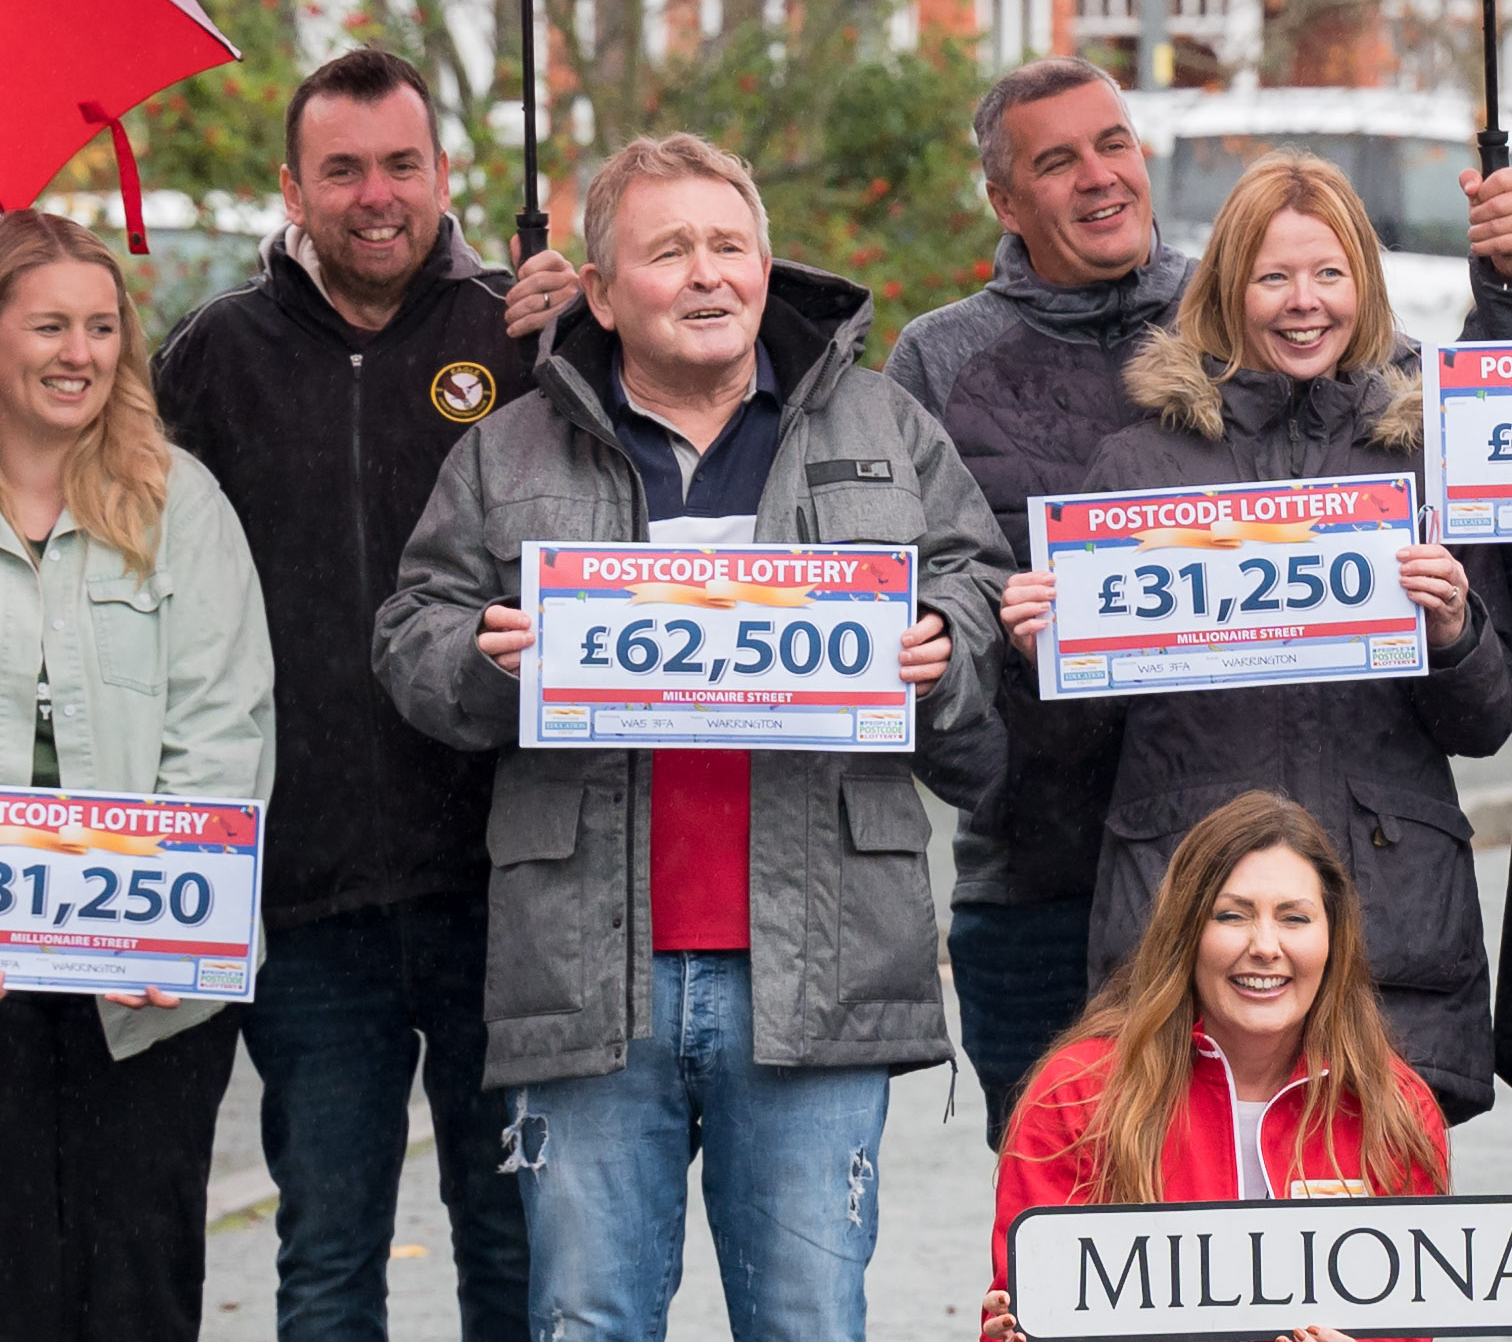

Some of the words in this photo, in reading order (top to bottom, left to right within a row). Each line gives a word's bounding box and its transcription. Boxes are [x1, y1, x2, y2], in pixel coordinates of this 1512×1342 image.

[1089, 499, 1233, 531] POSTCODE
[1241, 491, 1359, 521] LOTTERY
[583, 557, 729, 582] POSTCODE
[737, 559, 858, 583] LOTTERY
[1099, 552, 1374, 623] £31,250
[1177, 630, 1258, 644] MILLIONAIRE
[1259, 626, 1305, 639] STREET
[580, 619, 871, 683] £62,500
[1372, 651, 1416, 660] POSTCODE
[1137, 663, 1165, 674] WA5
[1168, 662, 1191, 672] 3FA
[1221, 654, 1297, 668] WARRINGTON
[663, 691, 744, 702] MILLIONAIRE
[747, 693, 793, 703] STREET
[621, 718, 647, 728] WA5
[651, 719, 674, 729] 3FA
[707, 719, 783, 730] WARRINGTON
[859, 725, 903, 735] POSTCODE
[90, 806, 210, 834] LOTTERY
[10, 932, 91, 946] MILLIONAIRE
[94, 937, 138, 949] STREET
